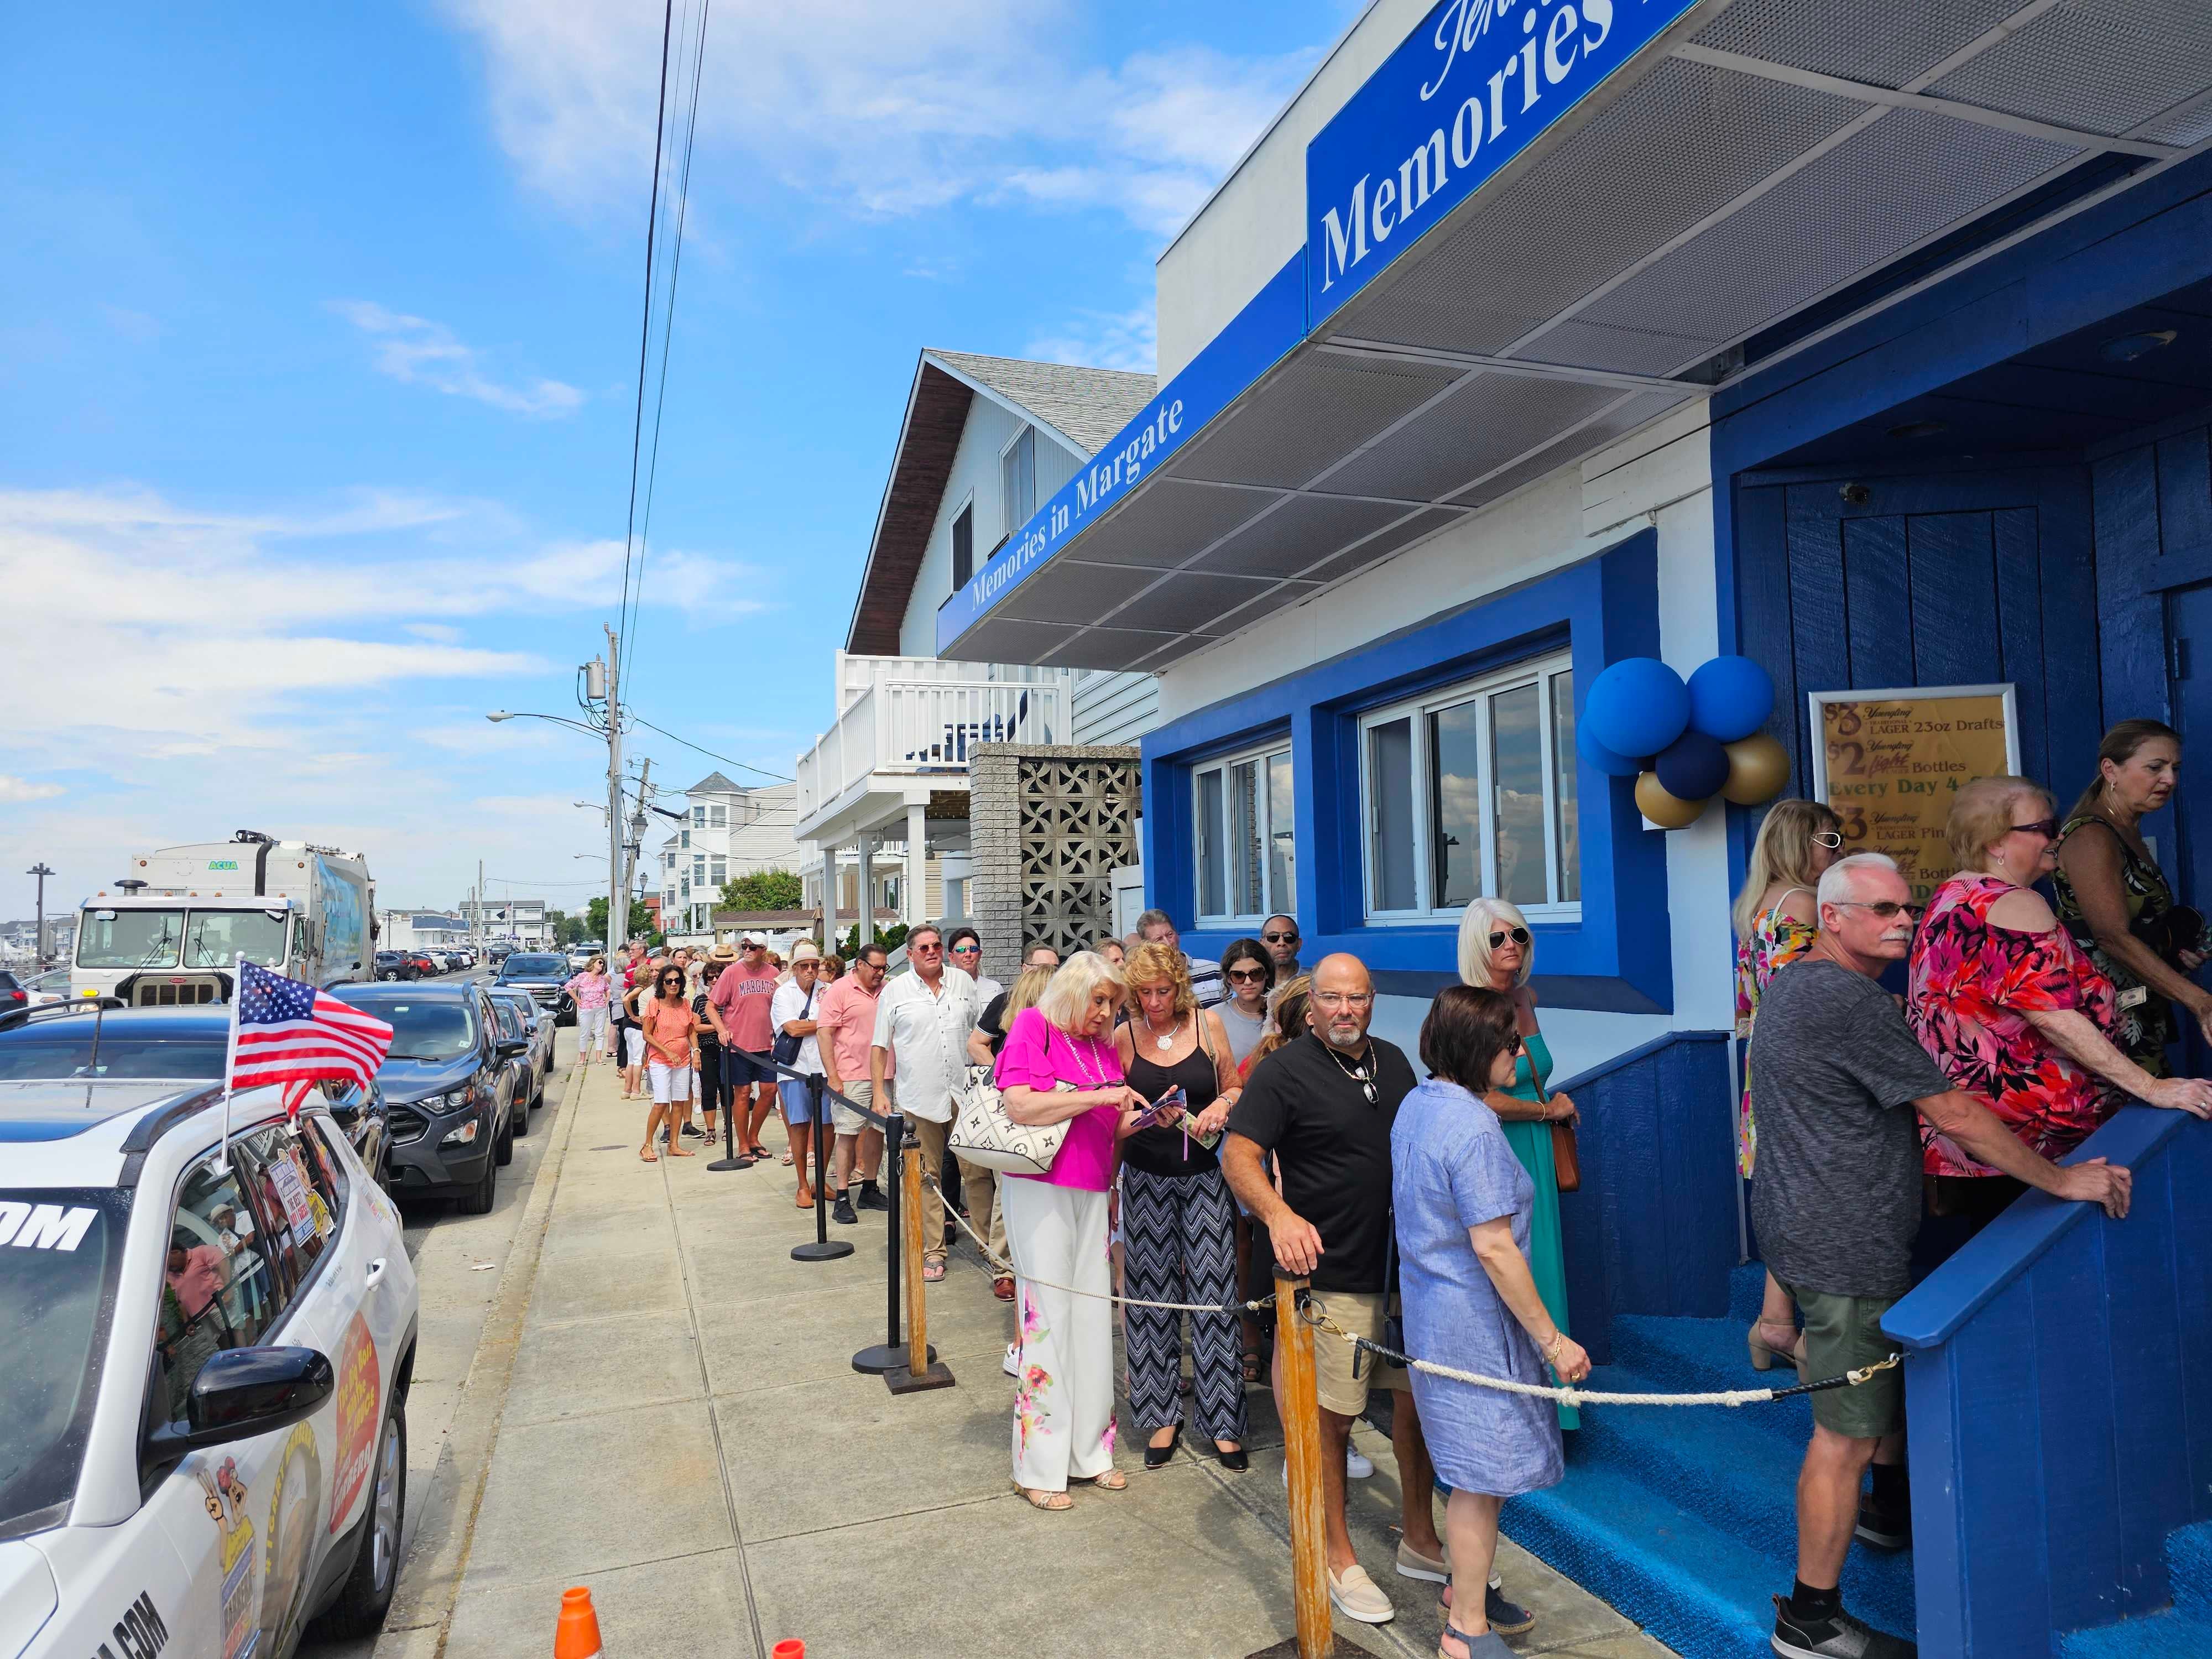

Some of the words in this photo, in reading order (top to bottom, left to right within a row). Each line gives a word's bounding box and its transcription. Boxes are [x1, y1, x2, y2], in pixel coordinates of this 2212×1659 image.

[1322, 0, 1613, 293] Memories
[972, 524, 1046, 612] Memories
[1051, 504, 1070, 541] in
[1075, 399, 1183, 520] Margate
[1863, 707, 1914, 719] Yuengling
[1870, 724, 1909, 735] LAGER
[1914, 721, 1950, 733] 23oz
[1956, 718, 2005, 731] Drafts
[1866, 739, 1914, 753] Yuengling
[1912, 761, 1966, 774] Bottles
[1829, 782, 1889, 797] Every
[1897, 778, 1938, 796] Day
[1870, 811, 1920, 825] Yuengling
[1877, 830, 1916, 840] LAGER
[208, 860, 238, 870] ACUA
